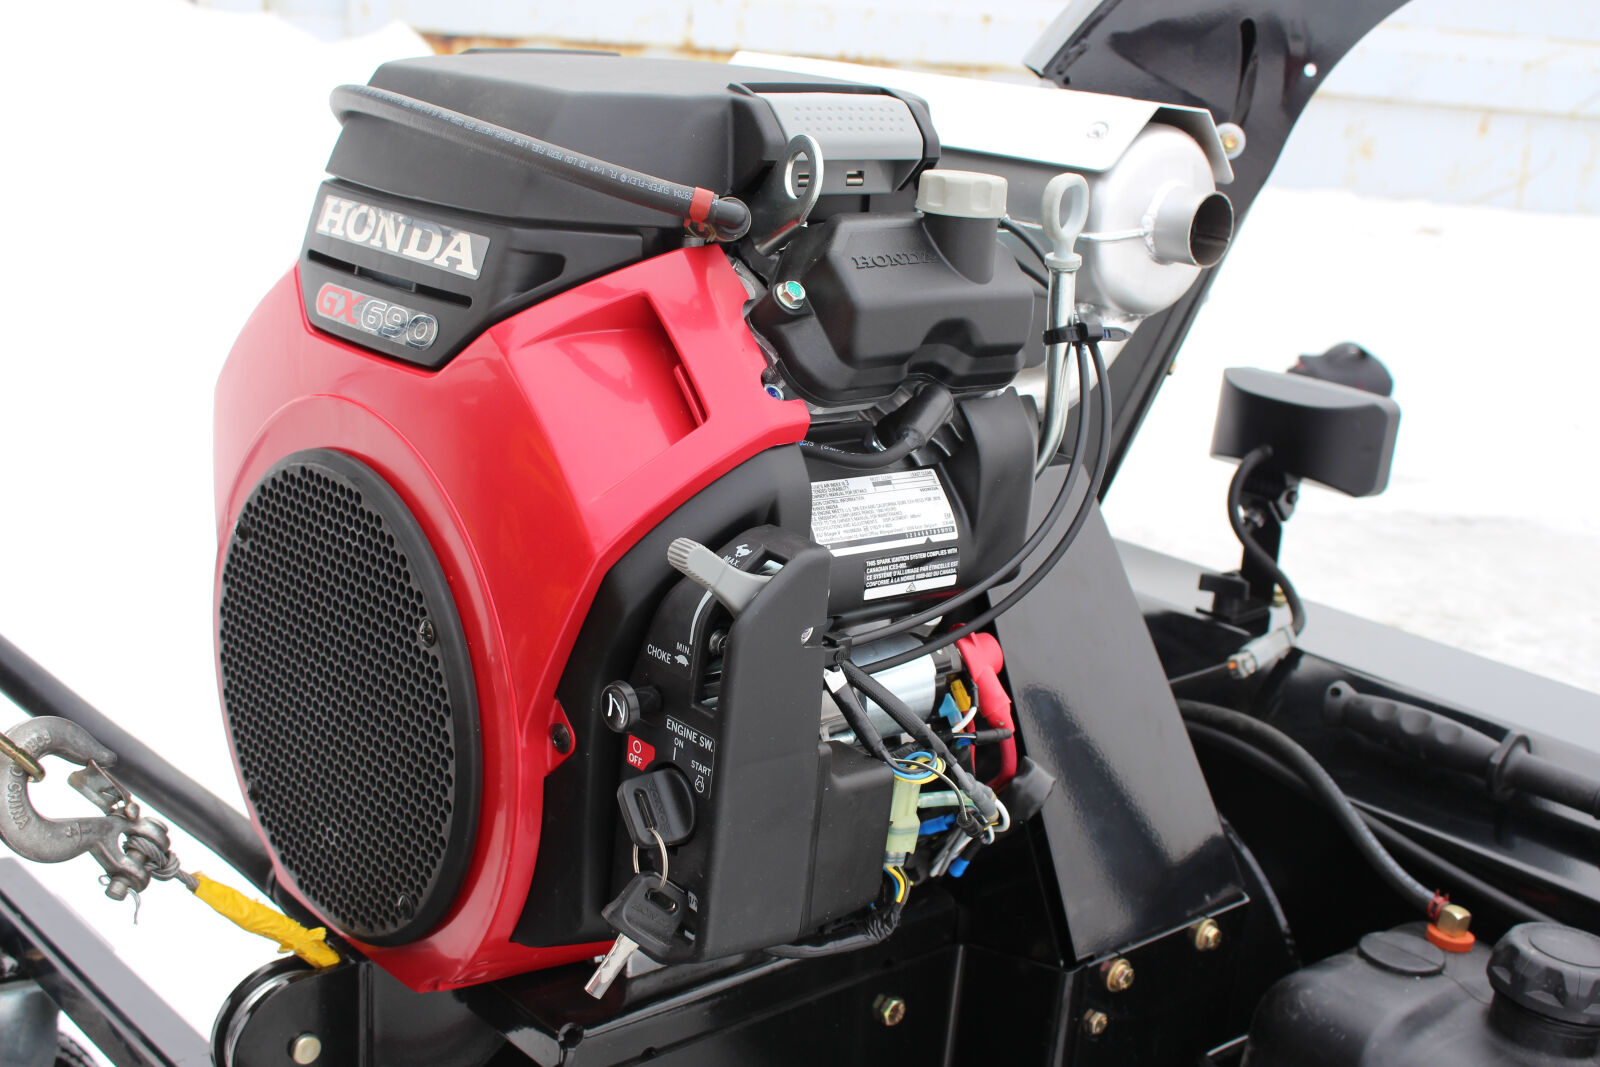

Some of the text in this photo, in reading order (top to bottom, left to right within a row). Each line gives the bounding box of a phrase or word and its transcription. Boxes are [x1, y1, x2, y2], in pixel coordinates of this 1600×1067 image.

[318, 195, 478, 276] HONDA
[851, 252, 940, 270] HONDA
[317, 283, 439, 347] GX690
[723, 555, 739, 567] MAX.
[877, 558, 892, 566] SPARK
[892, 555, 910, 564] IGNITION
[910, 553, 926, 561] SYSTEM
[926, 549, 947, 558] COMPLIES
[866, 565, 889, 574] CANADIAN
[866, 578, 890, 588] CONFORME
[901, 574, 916, 582] NORME
[647, 643, 672, 665] CHOKE
[676, 641, 692, 656] MIN.
[666, 718, 714, 752] ENGINE SW.
[674, 737, 684, 749] ON
[628, 752, 643, 766] OFF
[690, 759, 712, 777] START
[7, 781, 32, 830] CHINA
